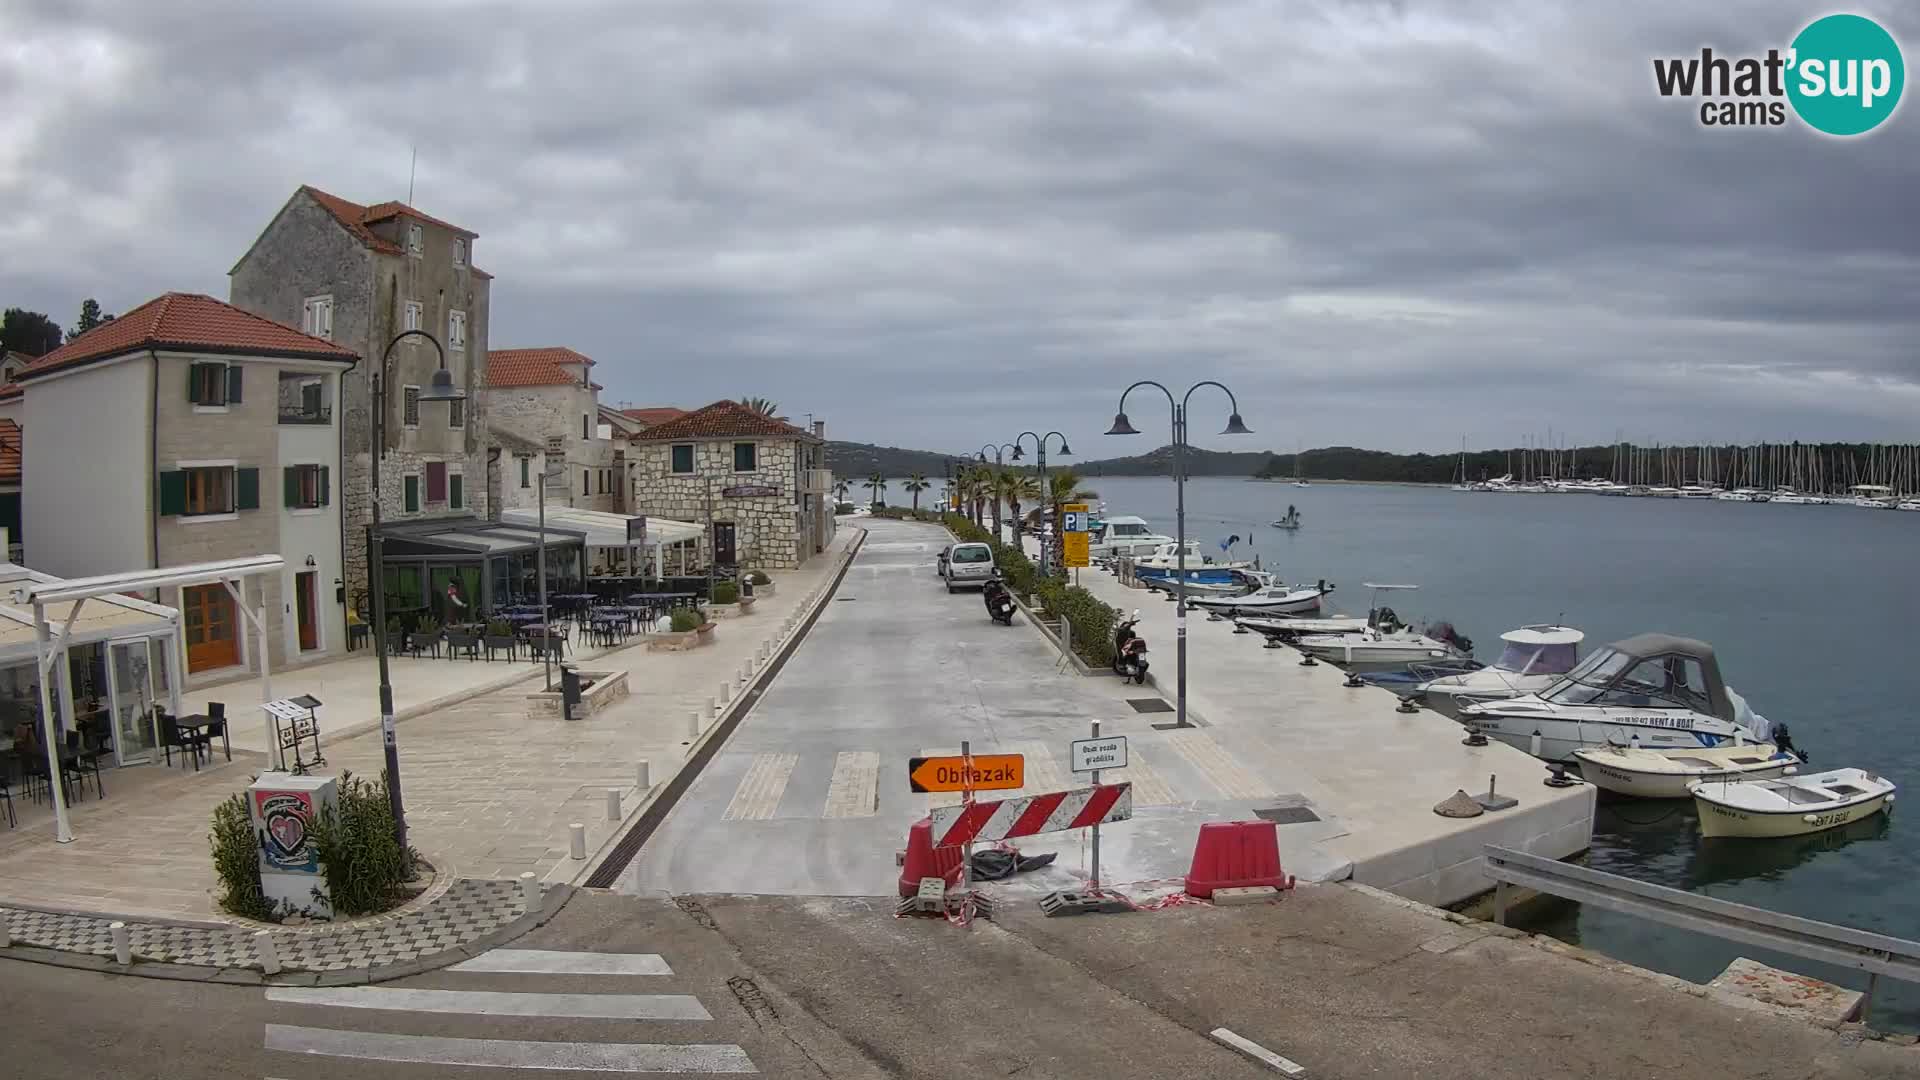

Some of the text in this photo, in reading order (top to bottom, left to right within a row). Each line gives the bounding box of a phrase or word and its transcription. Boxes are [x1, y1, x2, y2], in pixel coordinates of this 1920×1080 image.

[1065, 514, 1076, 530] P
[1649, 717, 1668, 728] RENT
[1669, 718, 1675, 728] A
[1676, 718, 1696, 729] BOAT
[936, 763, 1015, 784] Obilazak
